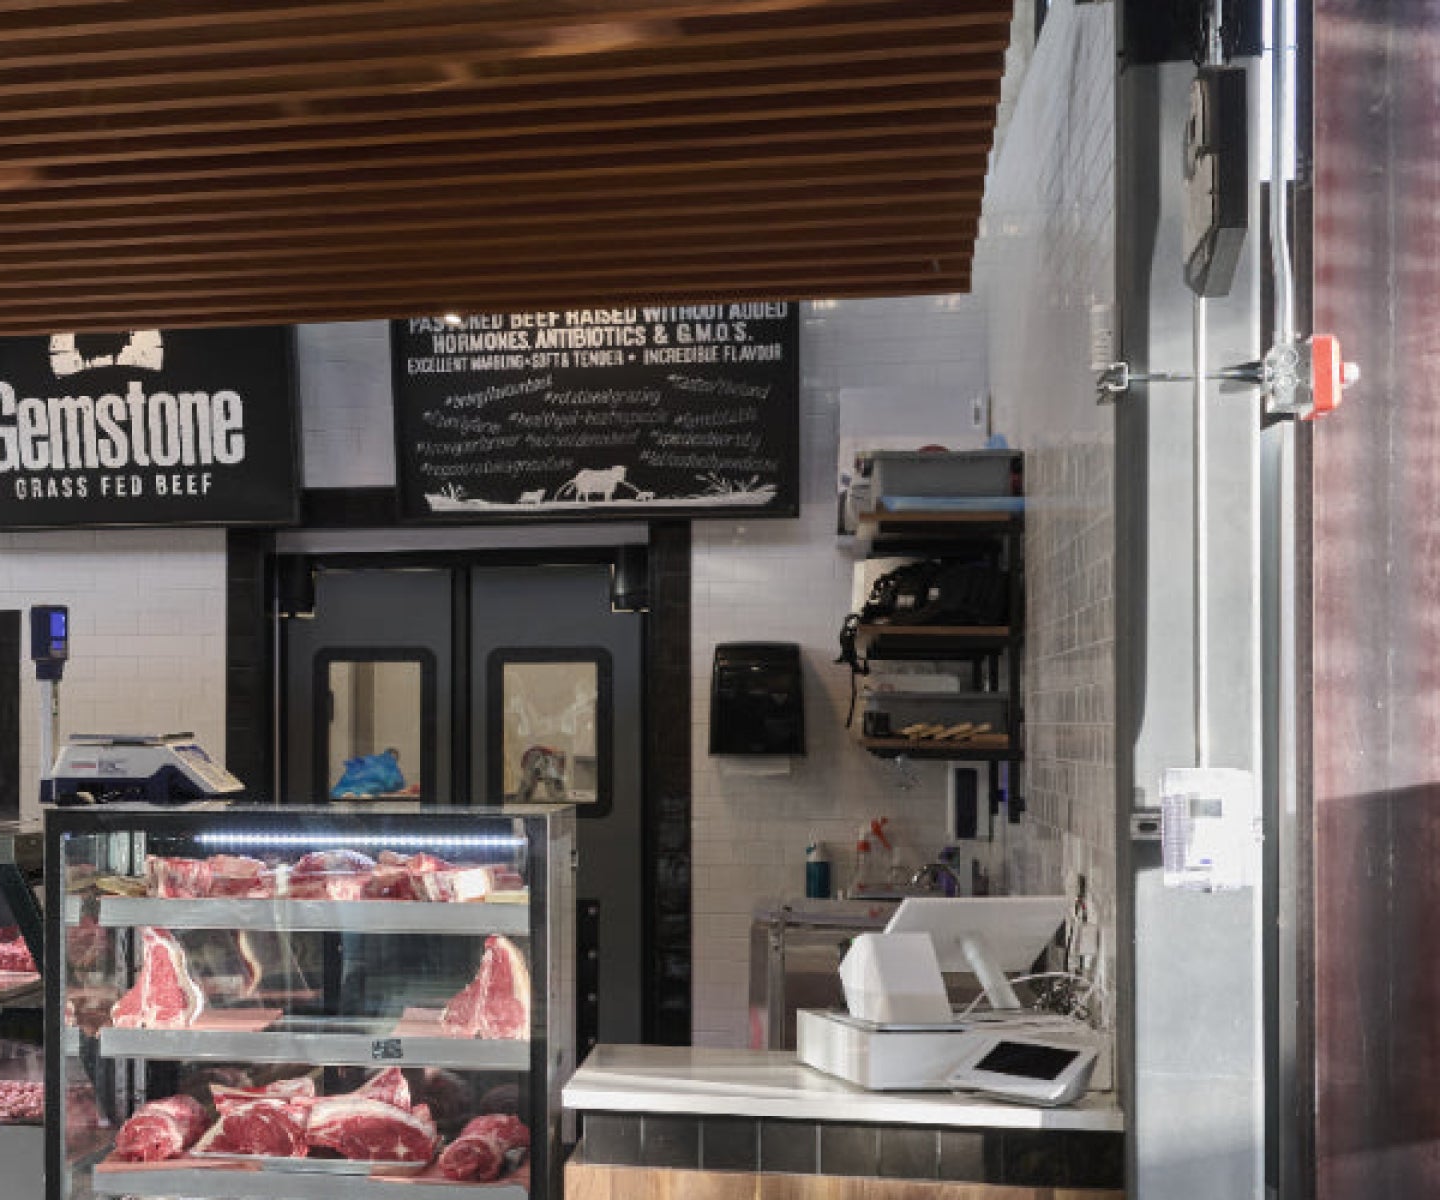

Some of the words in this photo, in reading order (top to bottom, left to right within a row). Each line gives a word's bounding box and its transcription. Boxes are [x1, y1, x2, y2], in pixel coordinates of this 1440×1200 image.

[409, 313, 503, 334] PASRED
[510, 311, 560, 330] BEEF
[564, 307, 636, 328] RAISED
[642, 303, 723, 323] WITHOUT
[729, 301, 788, 320] ADDED
[535, 325, 647, 350] ANTIBIOTICS
[654, 323, 668, 344] &
[407, 355, 468, 375] EXCELLENT
[471, 353, 524, 371] MARBLING
[574, 349, 625, 368] TENDER
[643, 346, 720, 366] INCREDIBLE
[724, 343, 781, 361] FLAVOUR
[16, 475, 87, 499] GRASS
[100, 475, 143, 498] FED
[155, 472, 212, 496] BEEF
